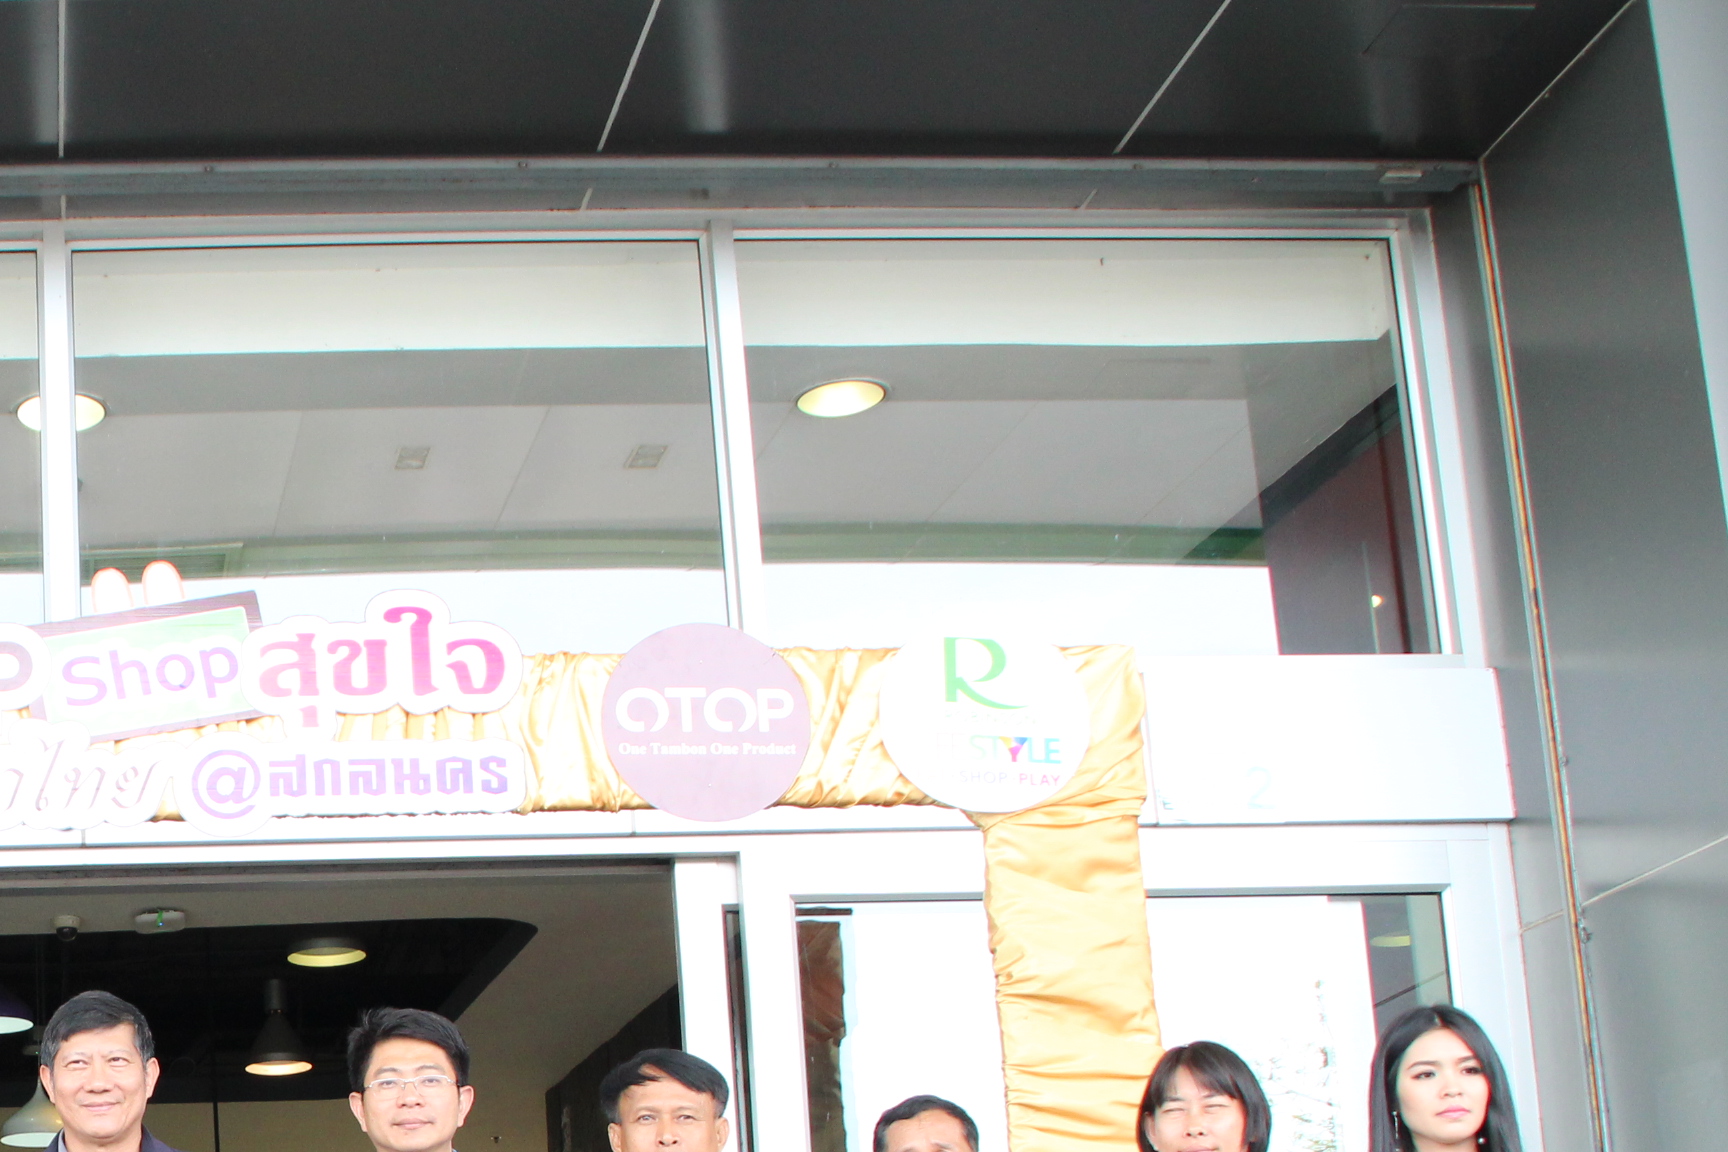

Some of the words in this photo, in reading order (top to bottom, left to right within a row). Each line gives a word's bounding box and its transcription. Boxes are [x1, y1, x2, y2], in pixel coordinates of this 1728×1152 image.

[61, 645, 239, 708] Shop
[257, 605, 506, 729] สุขใจ
[615, 687, 794, 733] OTOP
[618, 743, 647, 755] One
[649, 742, 707, 755] Tambon
[710, 742, 739, 755] One
[742, 743, 797, 755] Product
[959, 770, 1008, 784] SHOP
[1018, 772, 1061, 786] PLAY
